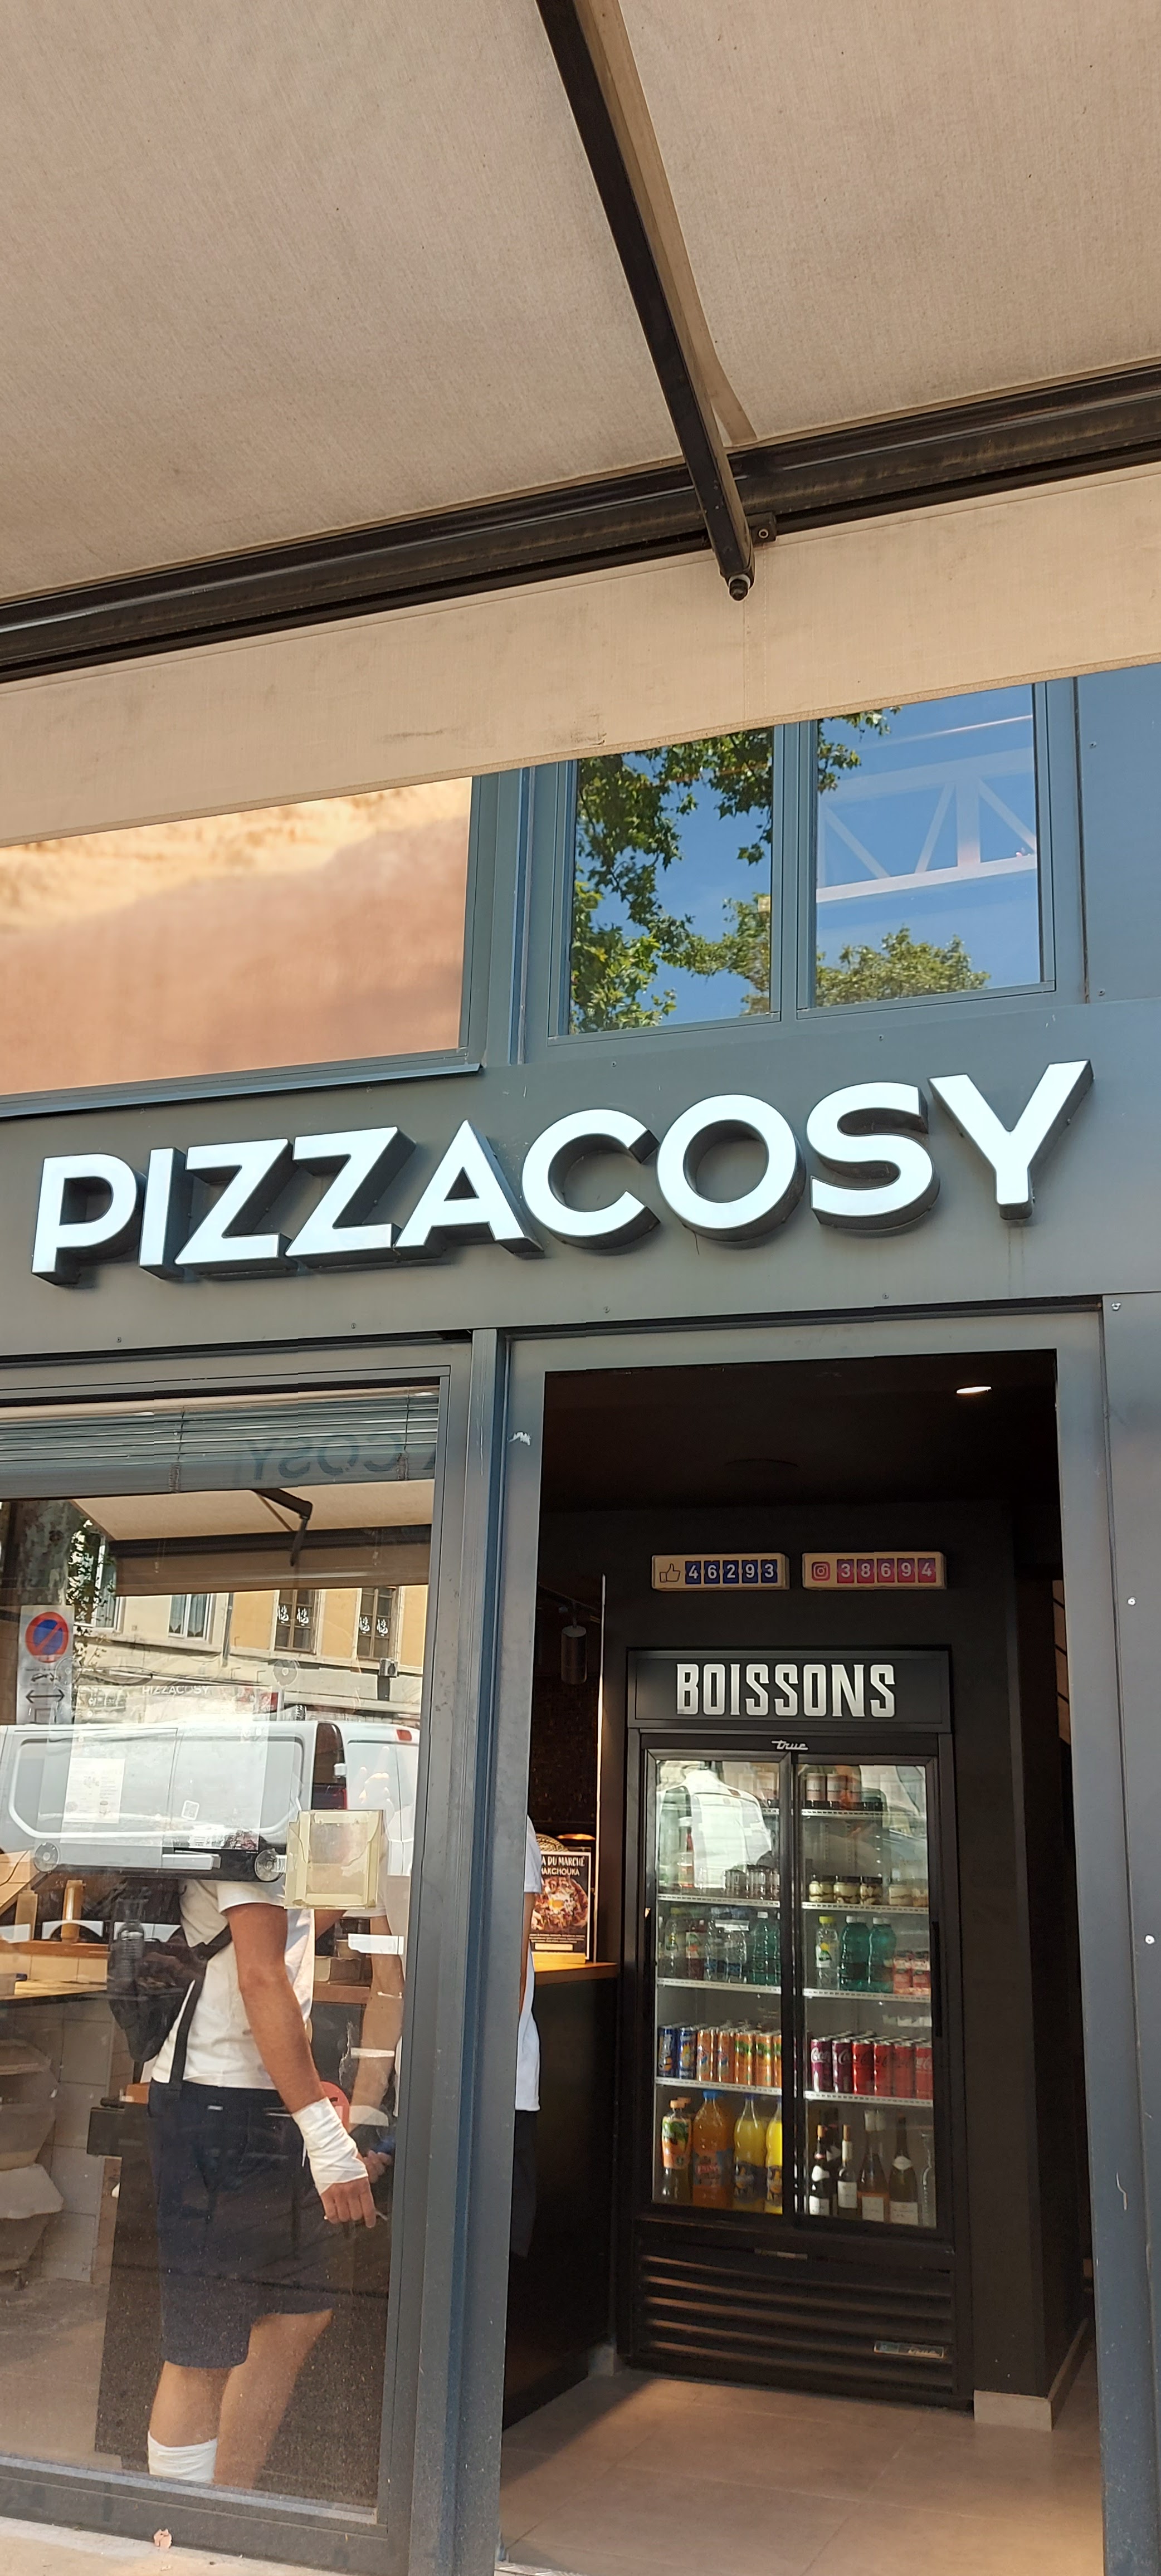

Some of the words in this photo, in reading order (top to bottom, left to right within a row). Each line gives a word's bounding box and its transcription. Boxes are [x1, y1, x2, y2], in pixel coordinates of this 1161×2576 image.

[32, 1059, 1092, 1282] PIZZACOSY
[686, 1563, 775, 1580] 46293
[840, 1562, 933, 1578] 38694
[676, 1663, 896, 1718] BOISSONS
[548, 1856, 557, 1866] DU
[558, 1856, 585, 1867] MARCHÉ
